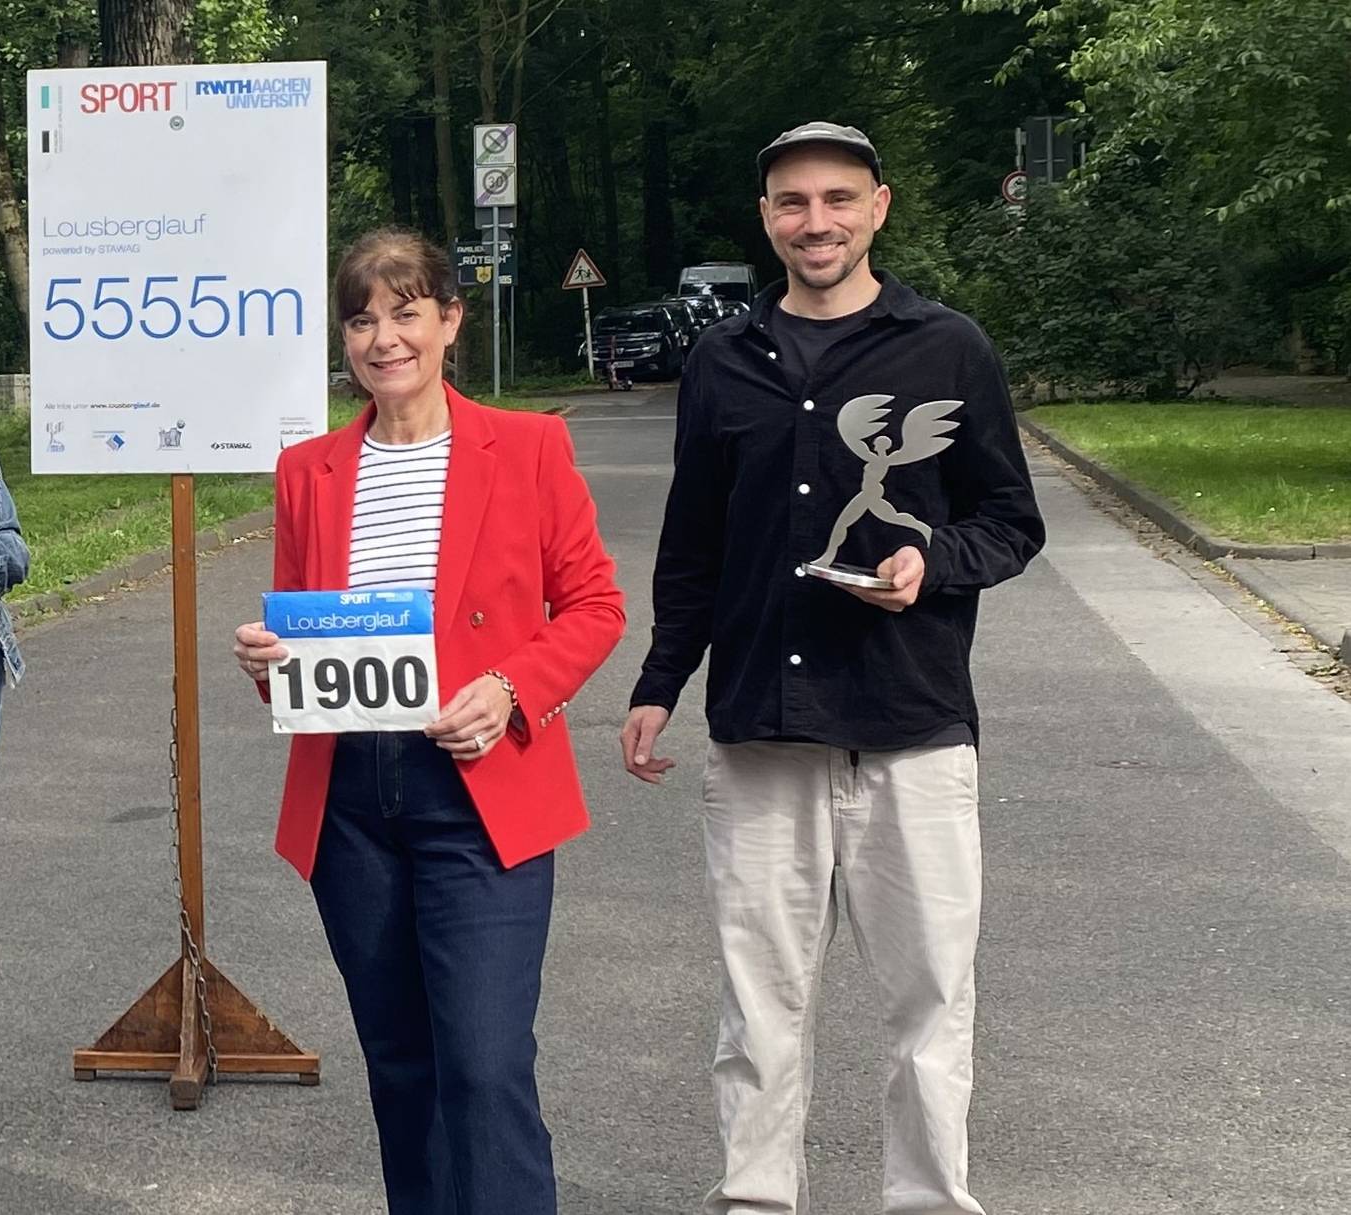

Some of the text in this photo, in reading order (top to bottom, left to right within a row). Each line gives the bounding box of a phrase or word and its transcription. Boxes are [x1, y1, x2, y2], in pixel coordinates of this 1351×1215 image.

[80, 81, 177, 113] SPORT
[226, 93, 311, 109] UNIVERSITY
[488, 176, 504, 189] 30
[42, 213, 207, 241] Lousberglauf
[42, 244, 141, 256] powered by STAWAG
[43, 275, 303, 341] 5555m
[340, 592, 372, 605] SPORT
[286, 609, 411, 632] Lousberglauf
[278, 655, 429, 710] 1900
